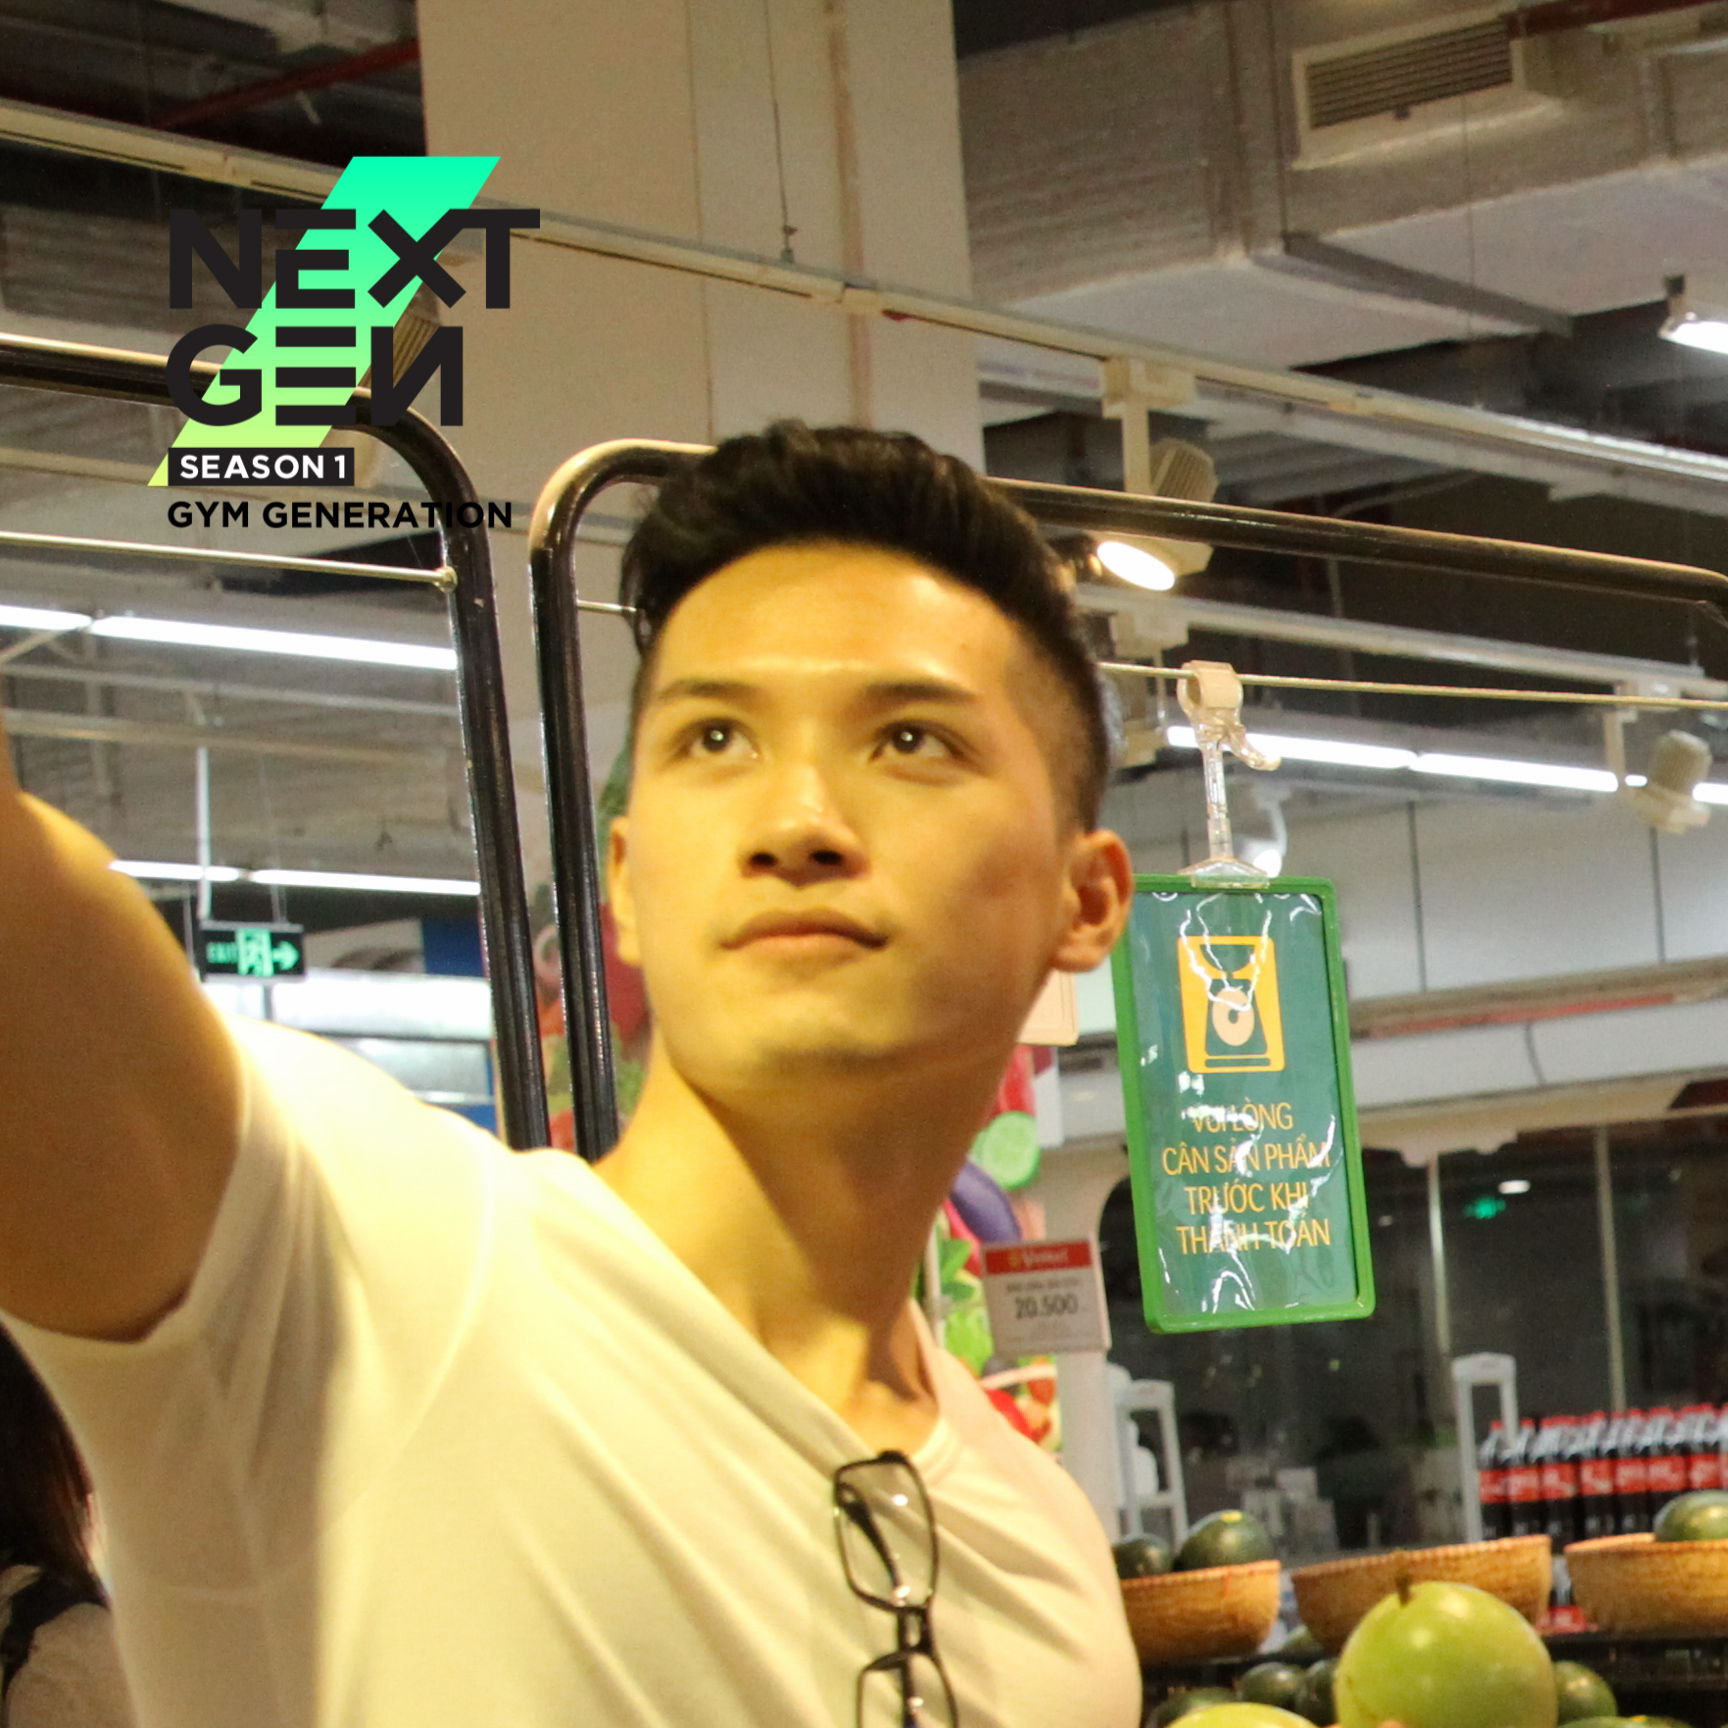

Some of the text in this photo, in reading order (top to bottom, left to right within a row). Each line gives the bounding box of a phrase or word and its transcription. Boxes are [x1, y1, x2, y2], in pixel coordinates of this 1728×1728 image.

[1231, 1097, 1294, 1132] LÒNG
[1162, 1133, 1332, 1176] CÂN SẢN PHẨM
[1184, 1178, 1310, 1215] TRƯỚC KHI
[1264, 1212, 1332, 1250] TOÁN
